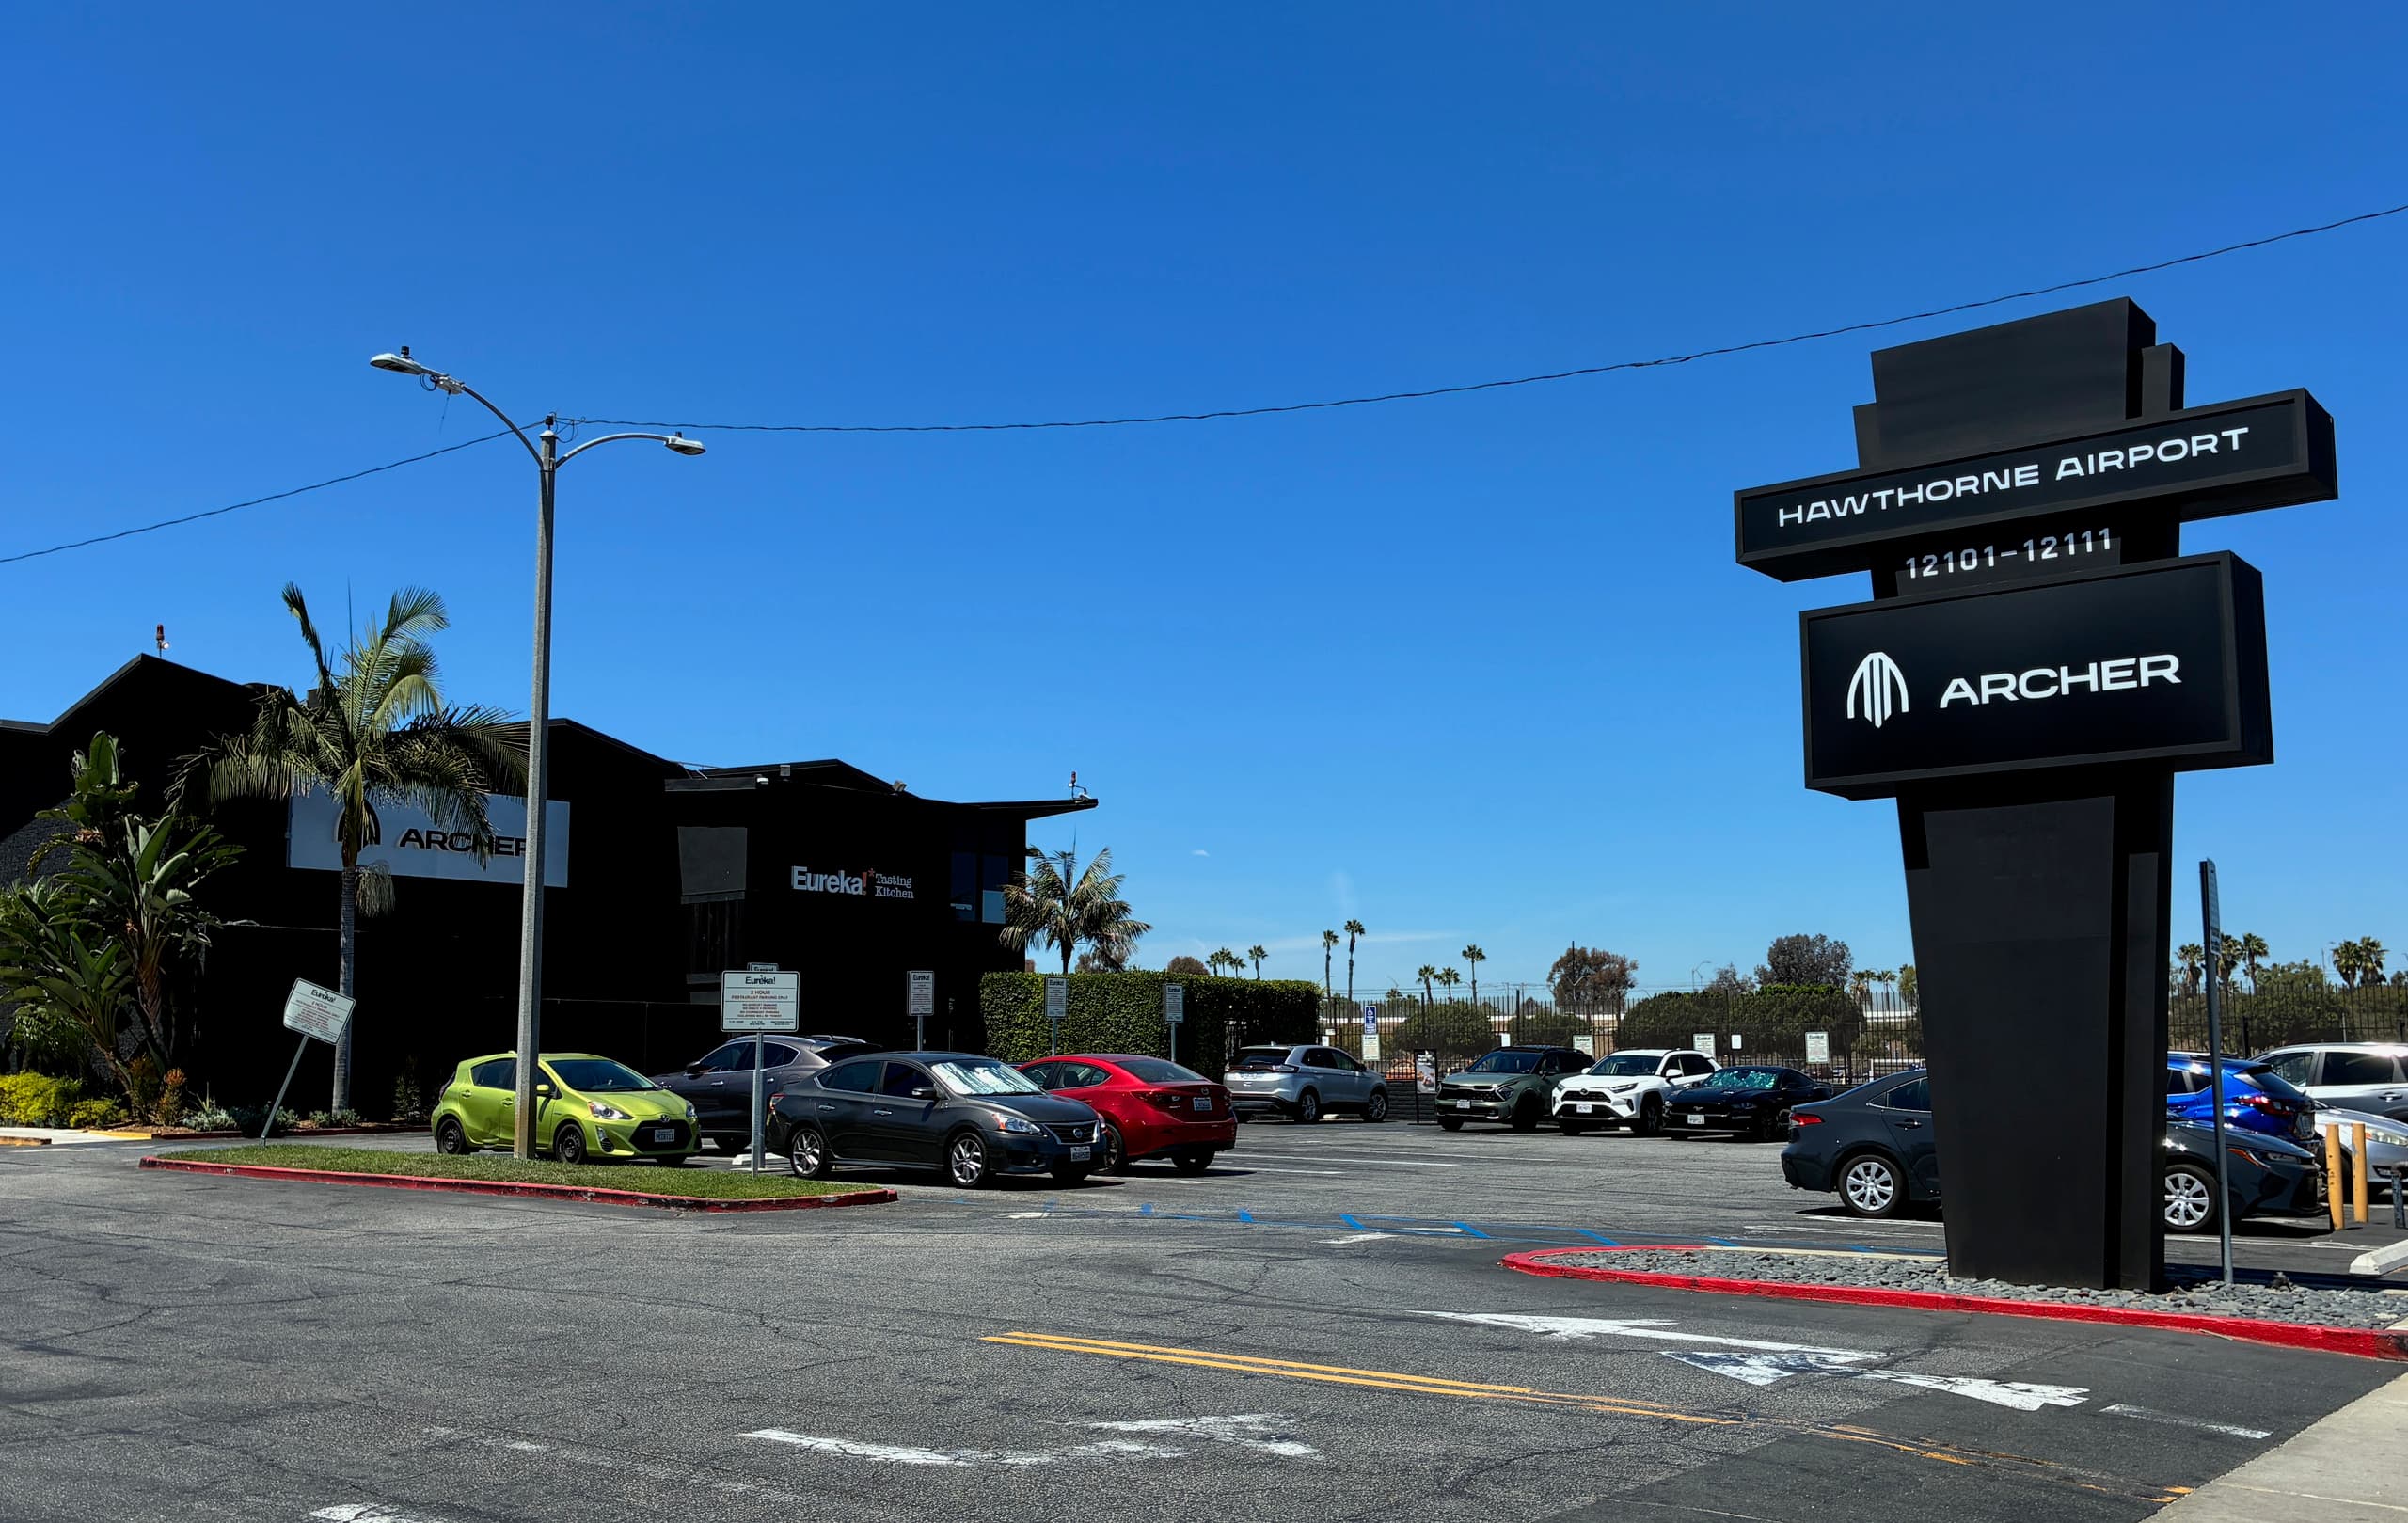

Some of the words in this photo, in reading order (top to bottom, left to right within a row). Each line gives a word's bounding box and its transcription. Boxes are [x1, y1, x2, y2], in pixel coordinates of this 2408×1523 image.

[1778, 463, 2040, 528] HAWTHORNE
[2054, 426, 2250, 482] AIRPORT
[1906, 527, 2112, 579] 12101-12111
[1938, 653, 2183, 710] ARCHER
[791, 865, 867, 896] Eureka!
[874, 885, 915, 899] Kitchen
[875, 873, 912, 889] Tasting
